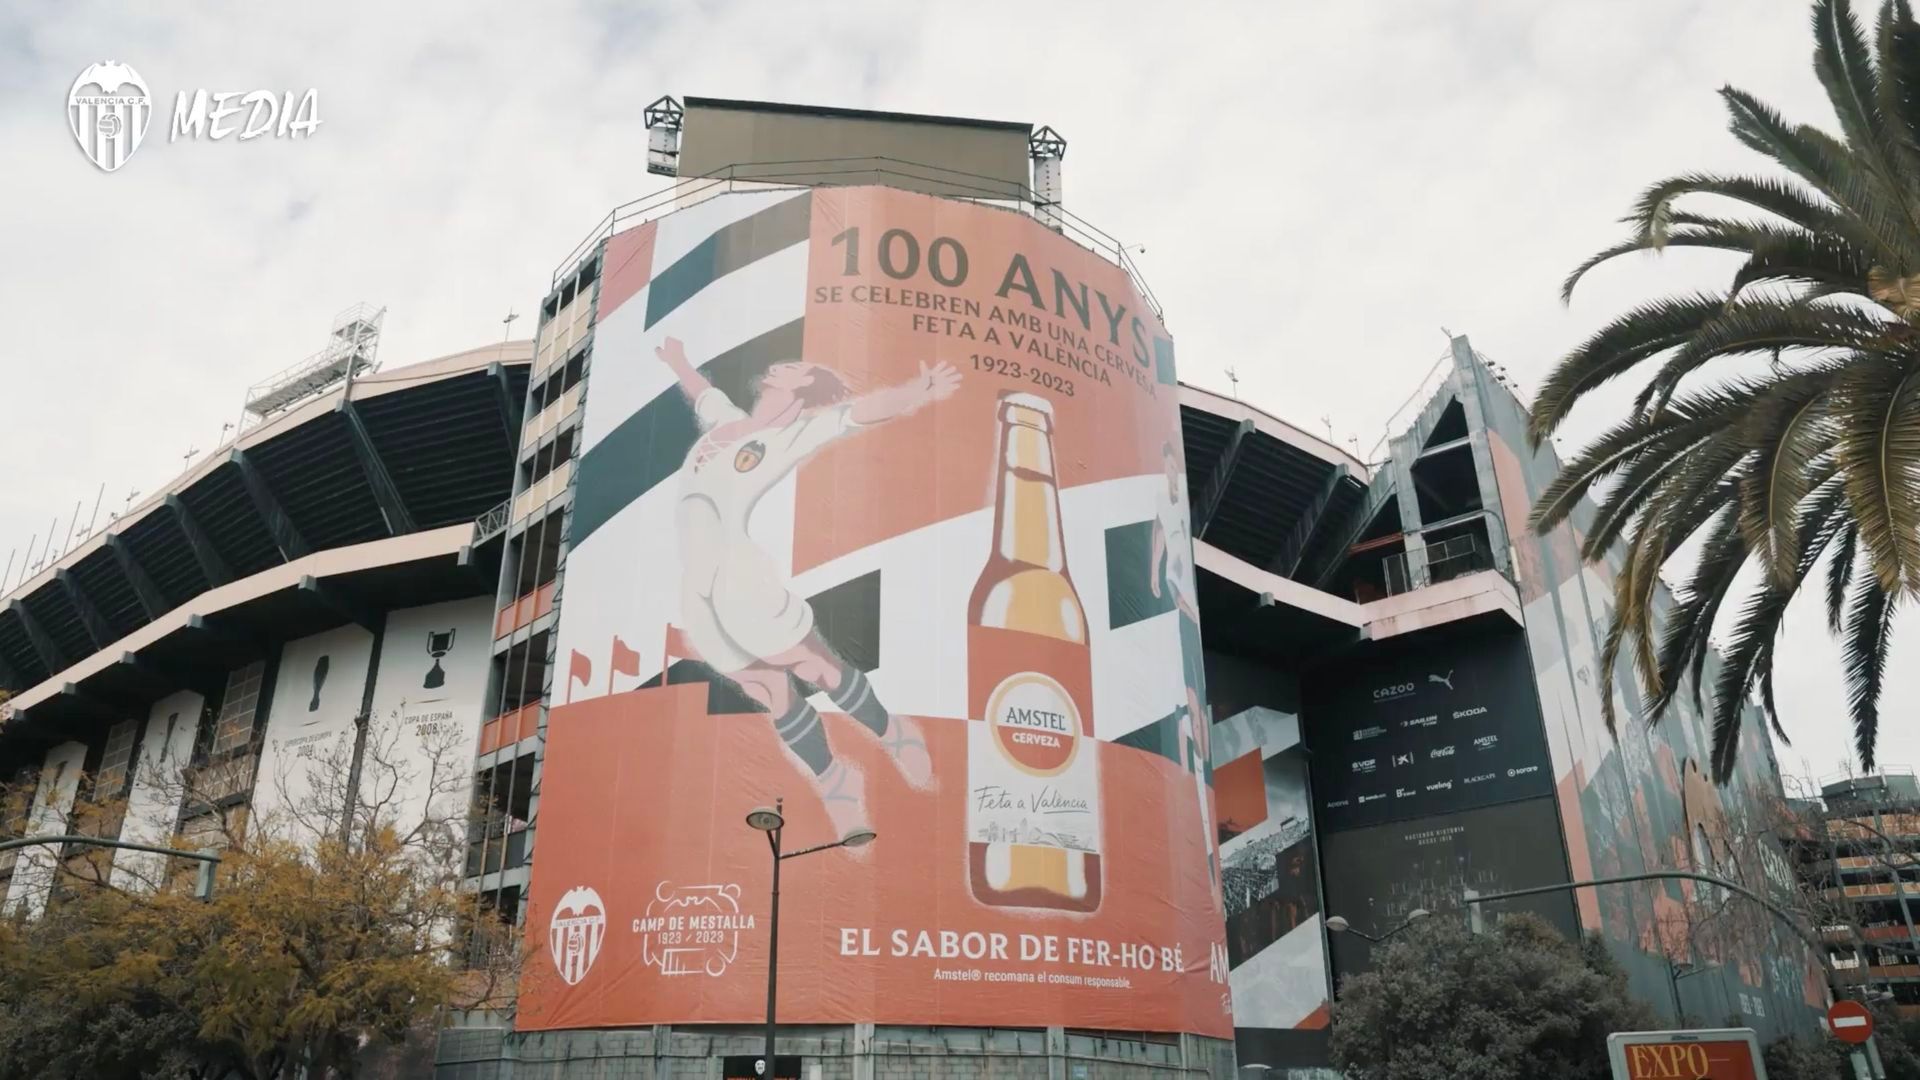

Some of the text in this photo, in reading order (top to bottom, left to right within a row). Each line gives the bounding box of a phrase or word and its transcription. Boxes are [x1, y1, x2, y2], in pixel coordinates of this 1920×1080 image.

[831, 226, 1149, 369] 100 ANYS
[814, 285, 1158, 400] SE CELEBREN AMB UNA CERVESA
[912, 313, 1112, 387] FETA A VALÈNCIA
[969, 354, 1075, 398] 1923-2023
[1373, 682, 1415, 699] CAZOO
[404, 711, 453, 725] COPA DE ESPAÑA
[1006, 707, 1066, 731] AMSTEL
[1452, 706, 1488, 720] ŠKODA
[415, 723, 439, 737] 2008
[1012, 731, 1061, 749] CERVEZA
[1473, 735, 1498, 746] AMSTEL
[1426, 780, 1452, 791] vueling
[974, 785, 1089, 813] Feta a València
[632, 914, 756, 933] CAMP DE MESTALLA
[658, 931, 682, 945] 1923
[695, 930, 724, 944] 2023
[840, 928, 1185, 973] EL SABOR DE FER-HO BÉ
[984, 970, 1035, 983] recomana
[1037, 973, 1047, 983] el
[1048, 974, 1083, 986] consum
[1631, 1043, 1710, 1078] EXPO
